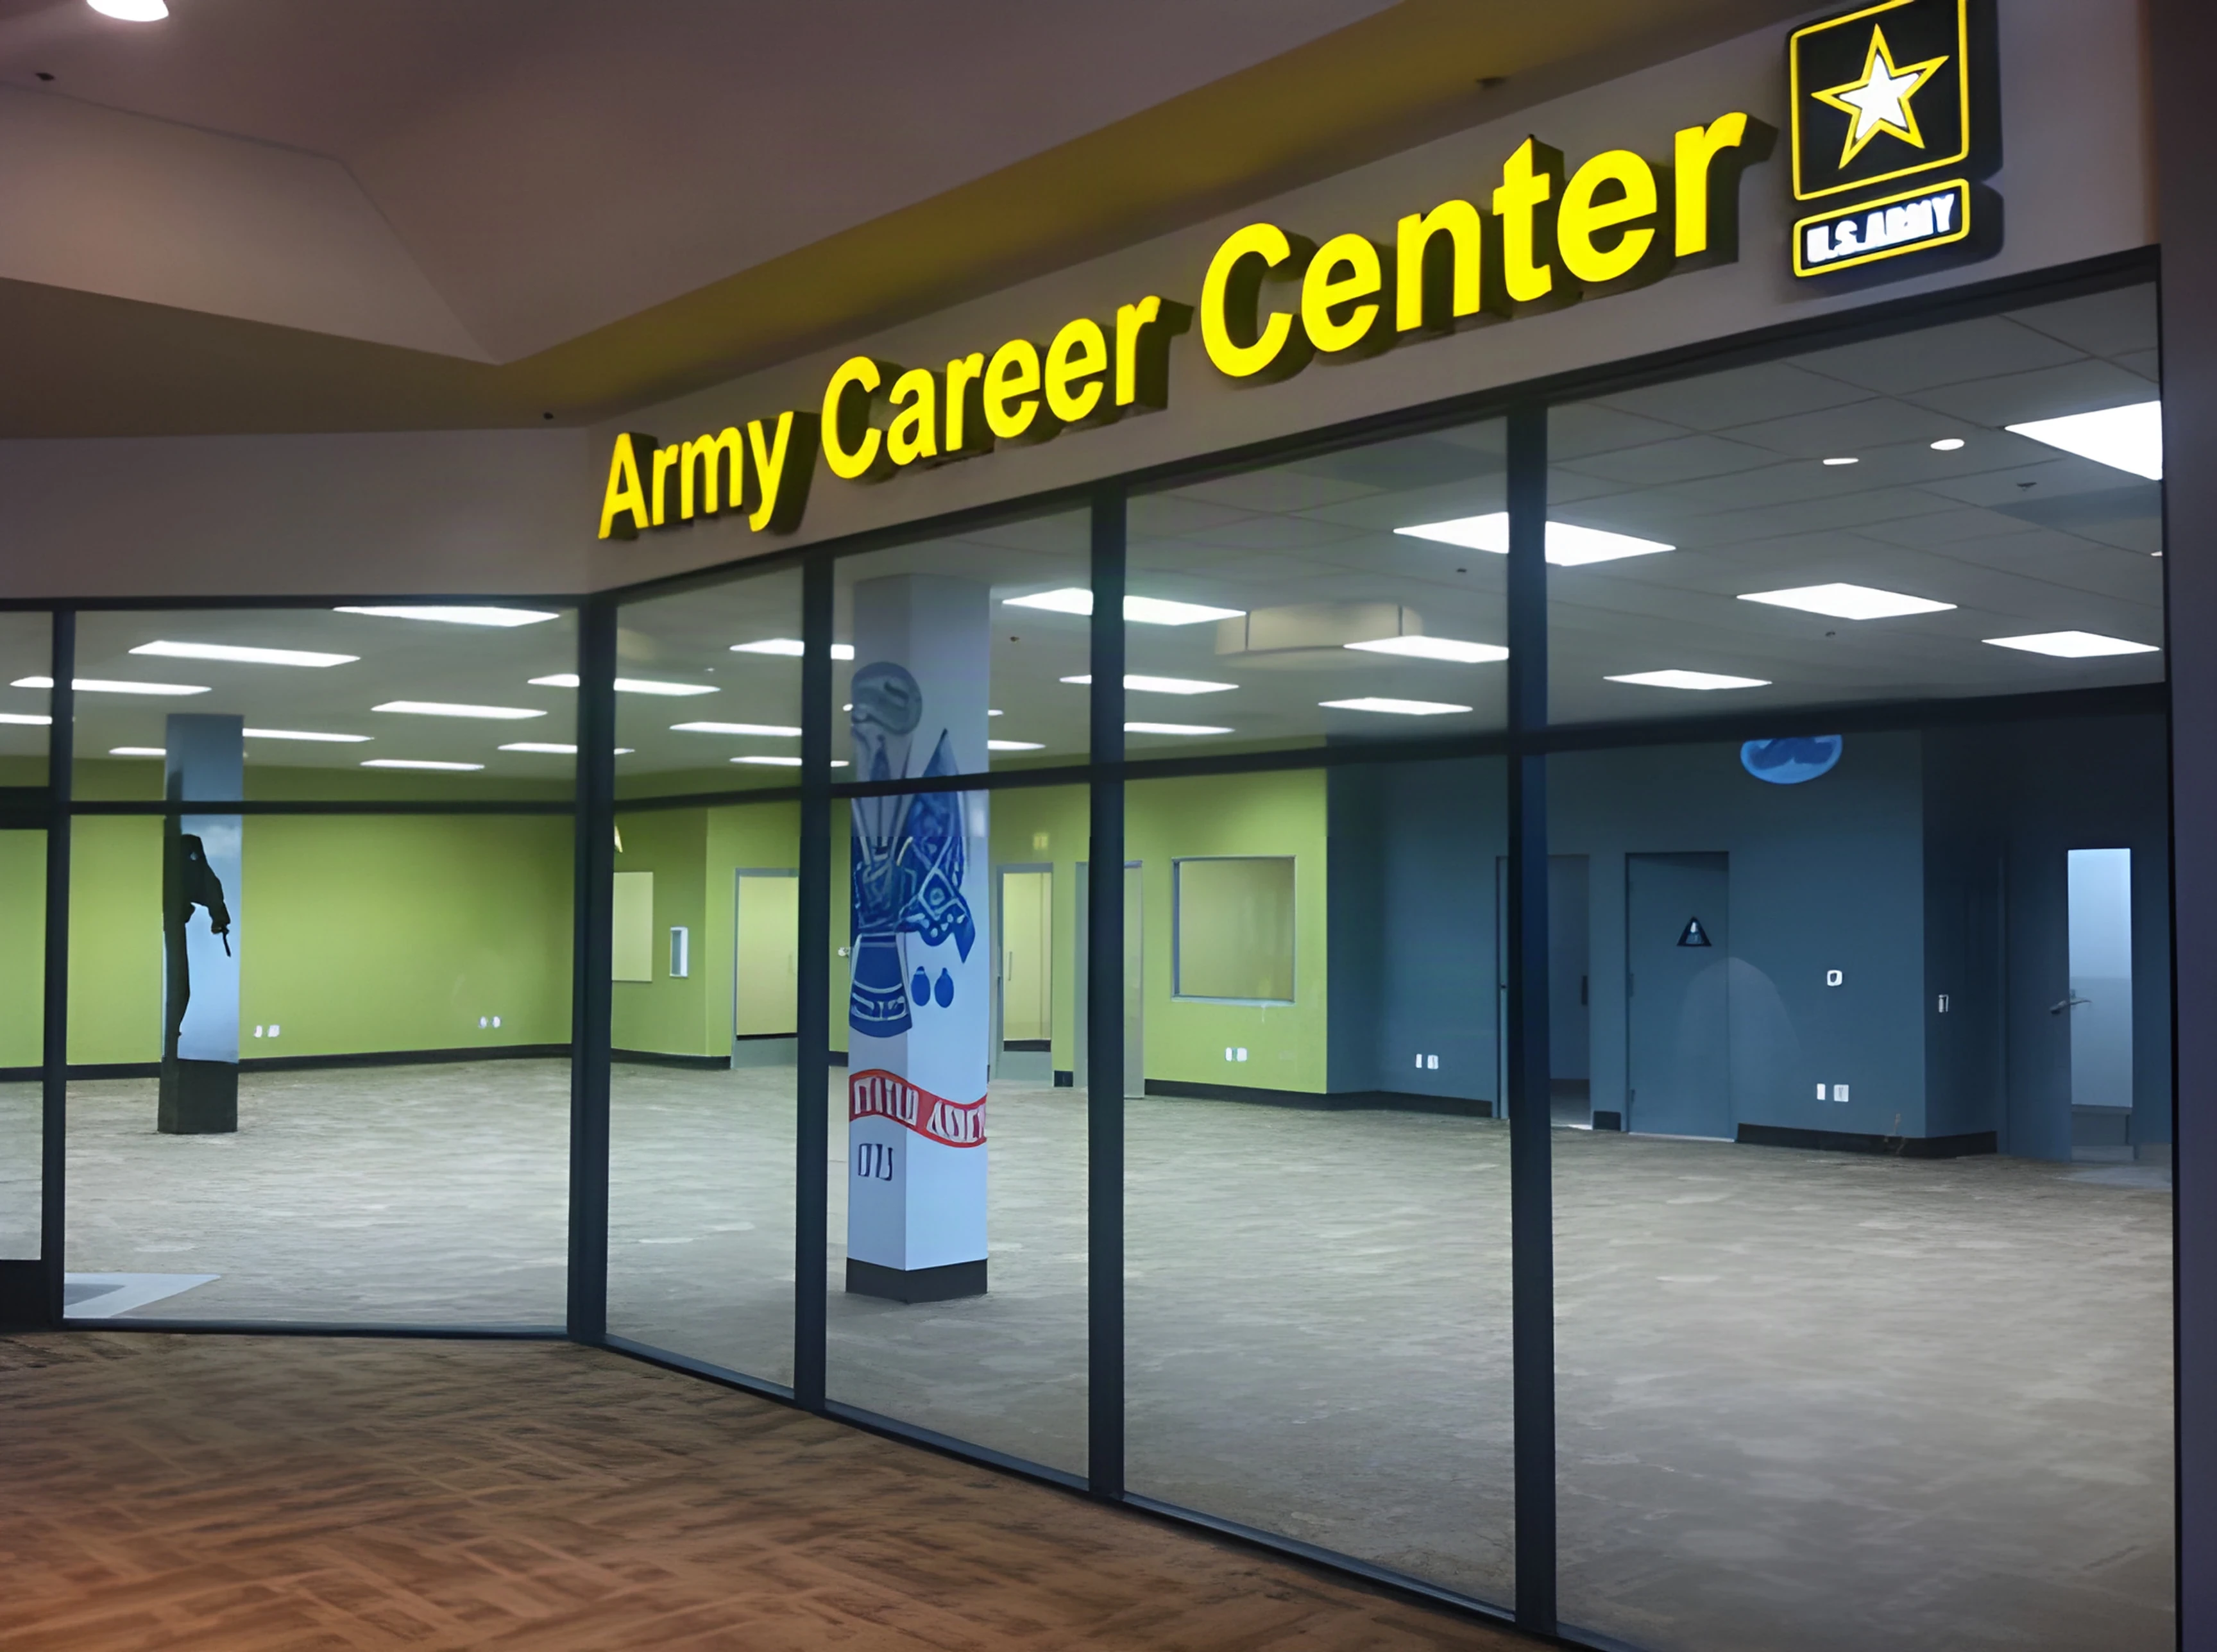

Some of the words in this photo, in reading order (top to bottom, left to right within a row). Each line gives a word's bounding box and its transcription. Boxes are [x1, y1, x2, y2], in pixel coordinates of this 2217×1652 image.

[599, 411, 794, 539] Army
[821, 296, 1160, 479] Career
[1200, 112, 1747, 378] Center
